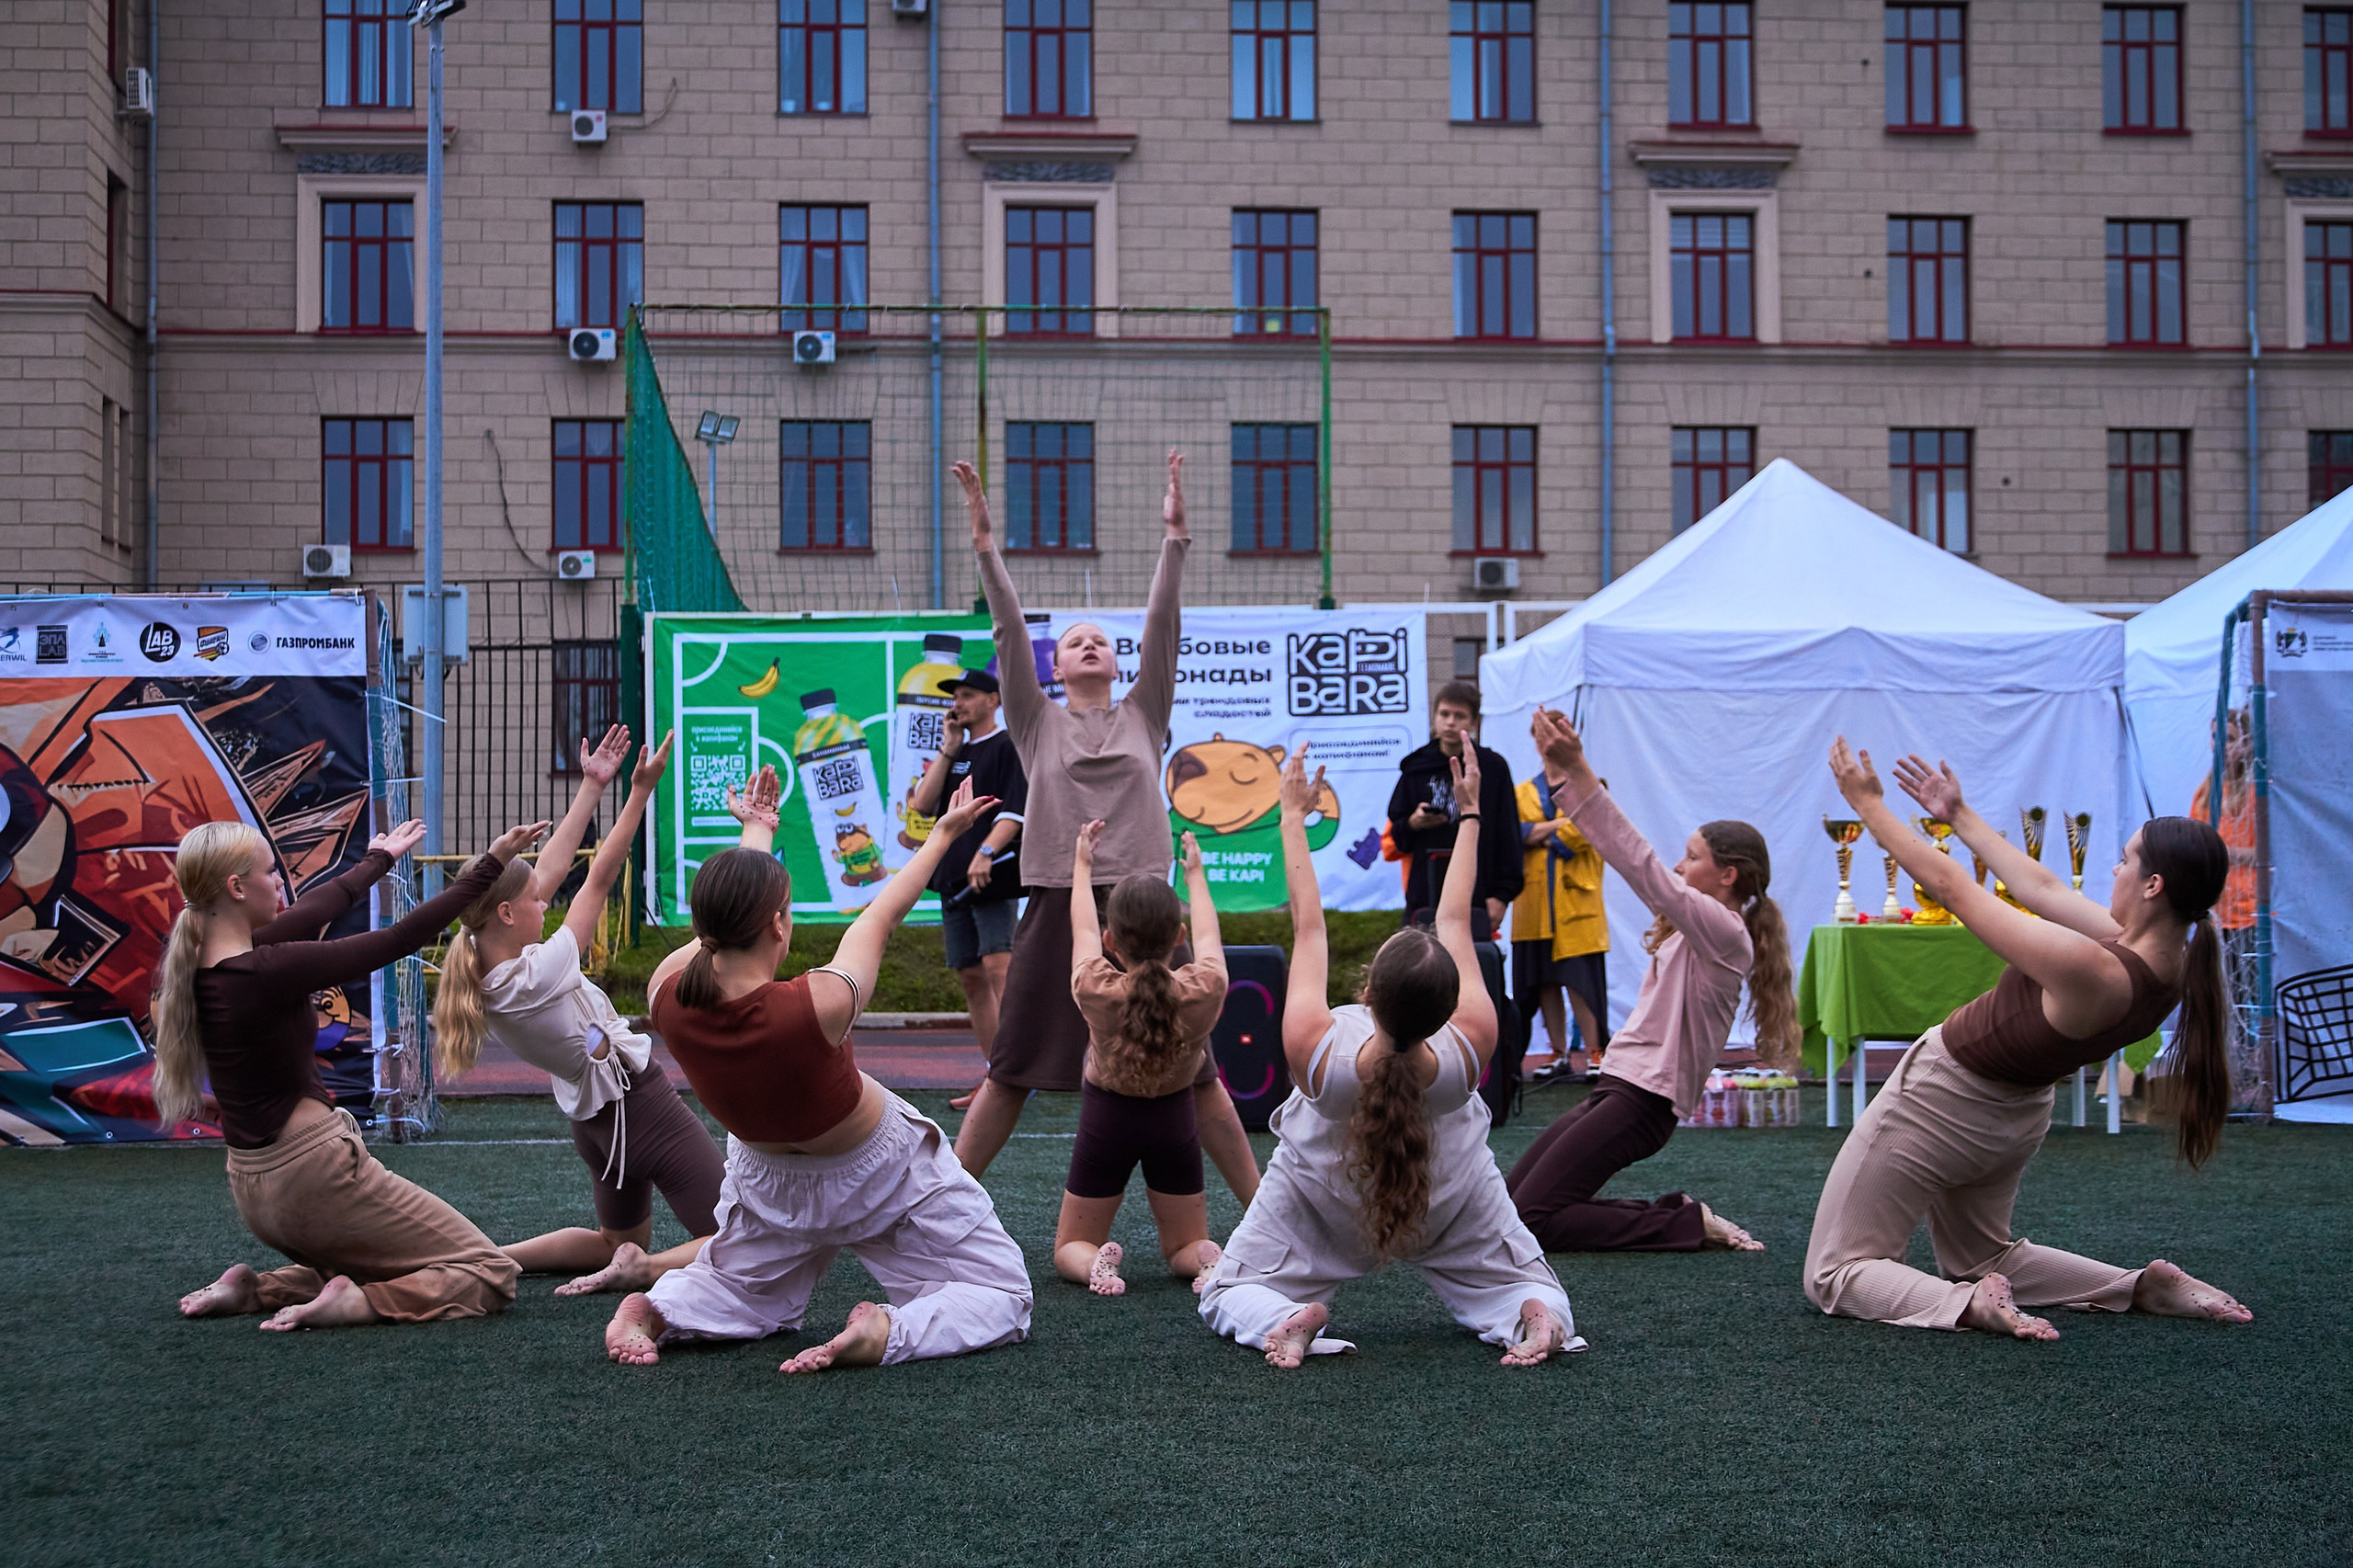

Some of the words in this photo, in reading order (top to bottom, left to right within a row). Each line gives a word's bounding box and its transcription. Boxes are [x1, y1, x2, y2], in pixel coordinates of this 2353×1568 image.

[145, 623, 174, 653] LAB
[276, 637, 355, 649] ГАЗПРОМБАНК
[160, 644, 175, 657] 23
[1116, 636, 1271, 655] Вбовые
[1116, 668, 1271, 685] ионады
[1200, 852, 1220, 865] BE
[1222, 852, 1273, 866] HAPPY
[1208, 869, 1227, 882] BE
[1229, 869, 1265, 882] KAPI
